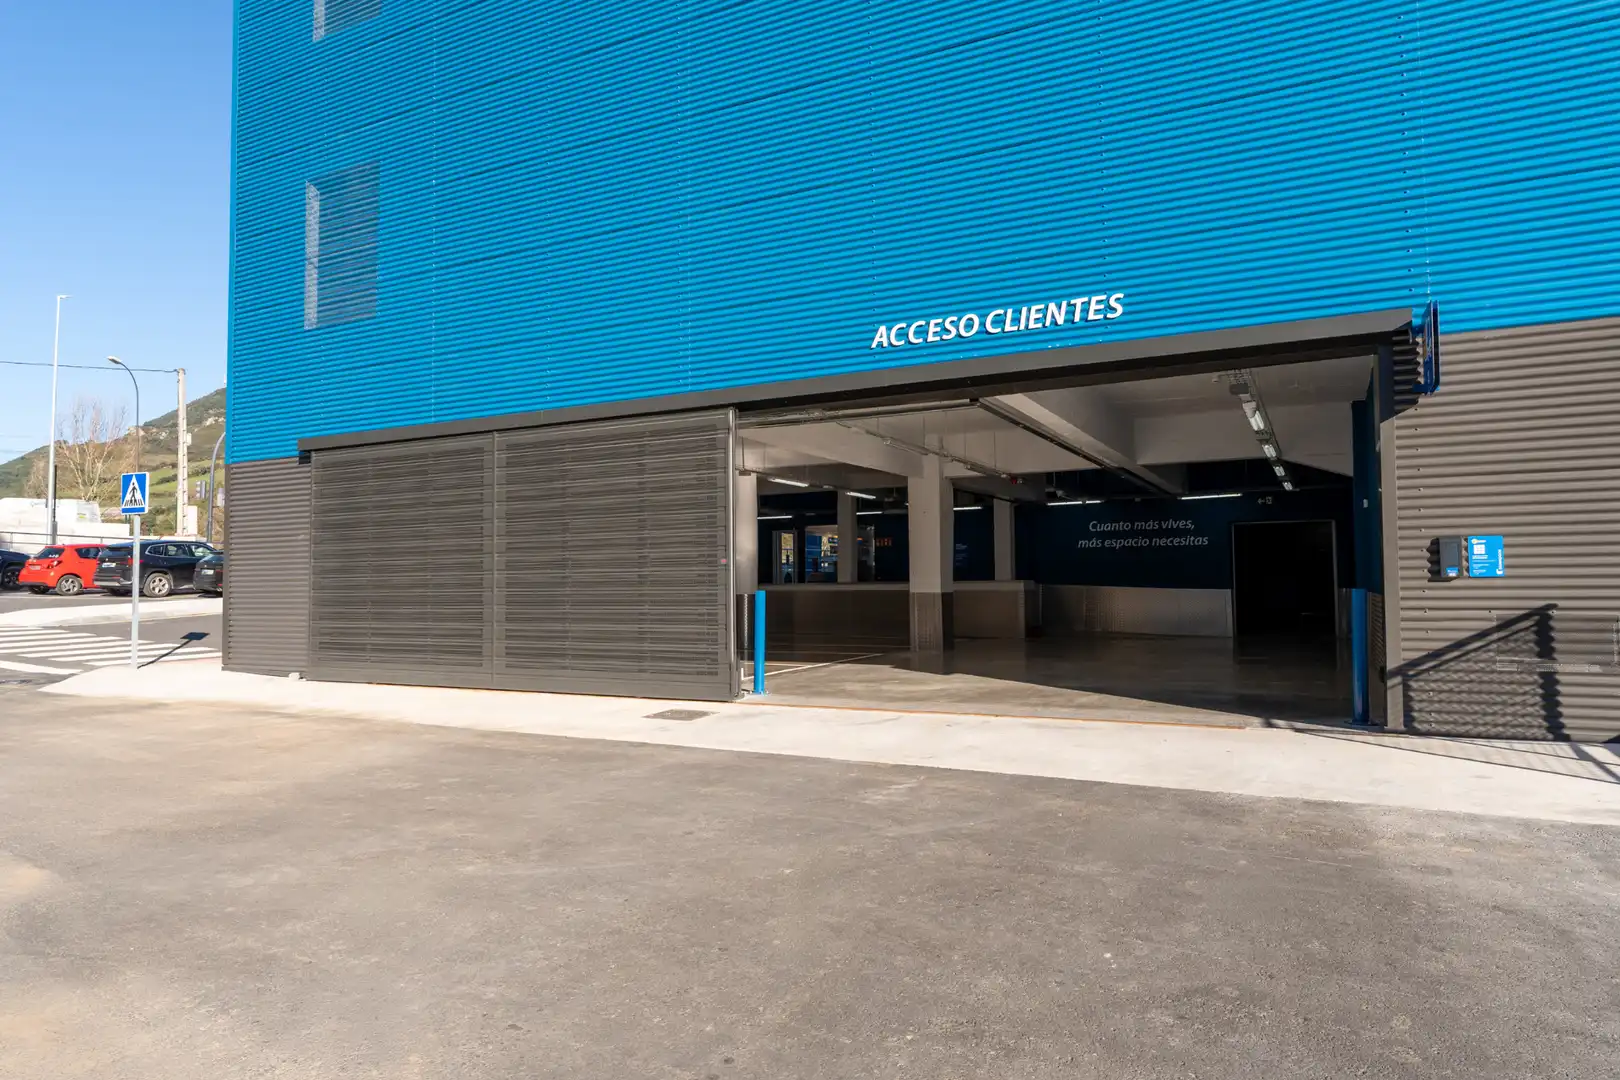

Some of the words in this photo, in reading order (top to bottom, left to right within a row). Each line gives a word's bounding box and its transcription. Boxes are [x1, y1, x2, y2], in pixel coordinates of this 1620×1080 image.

[870, 313, 980, 349] ACCESO
[984, 292, 1125, 335] CLIENTES
[1088, 520, 1132, 532] Cuanto
[1135, 519, 1159, 530] más
[1161, 518, 1195, 531] vives,
[1077, 537, 1102, 549] más
[1104, 536, 1149, 550] espacio
[1152, 535, 1209, 547] necesitas
